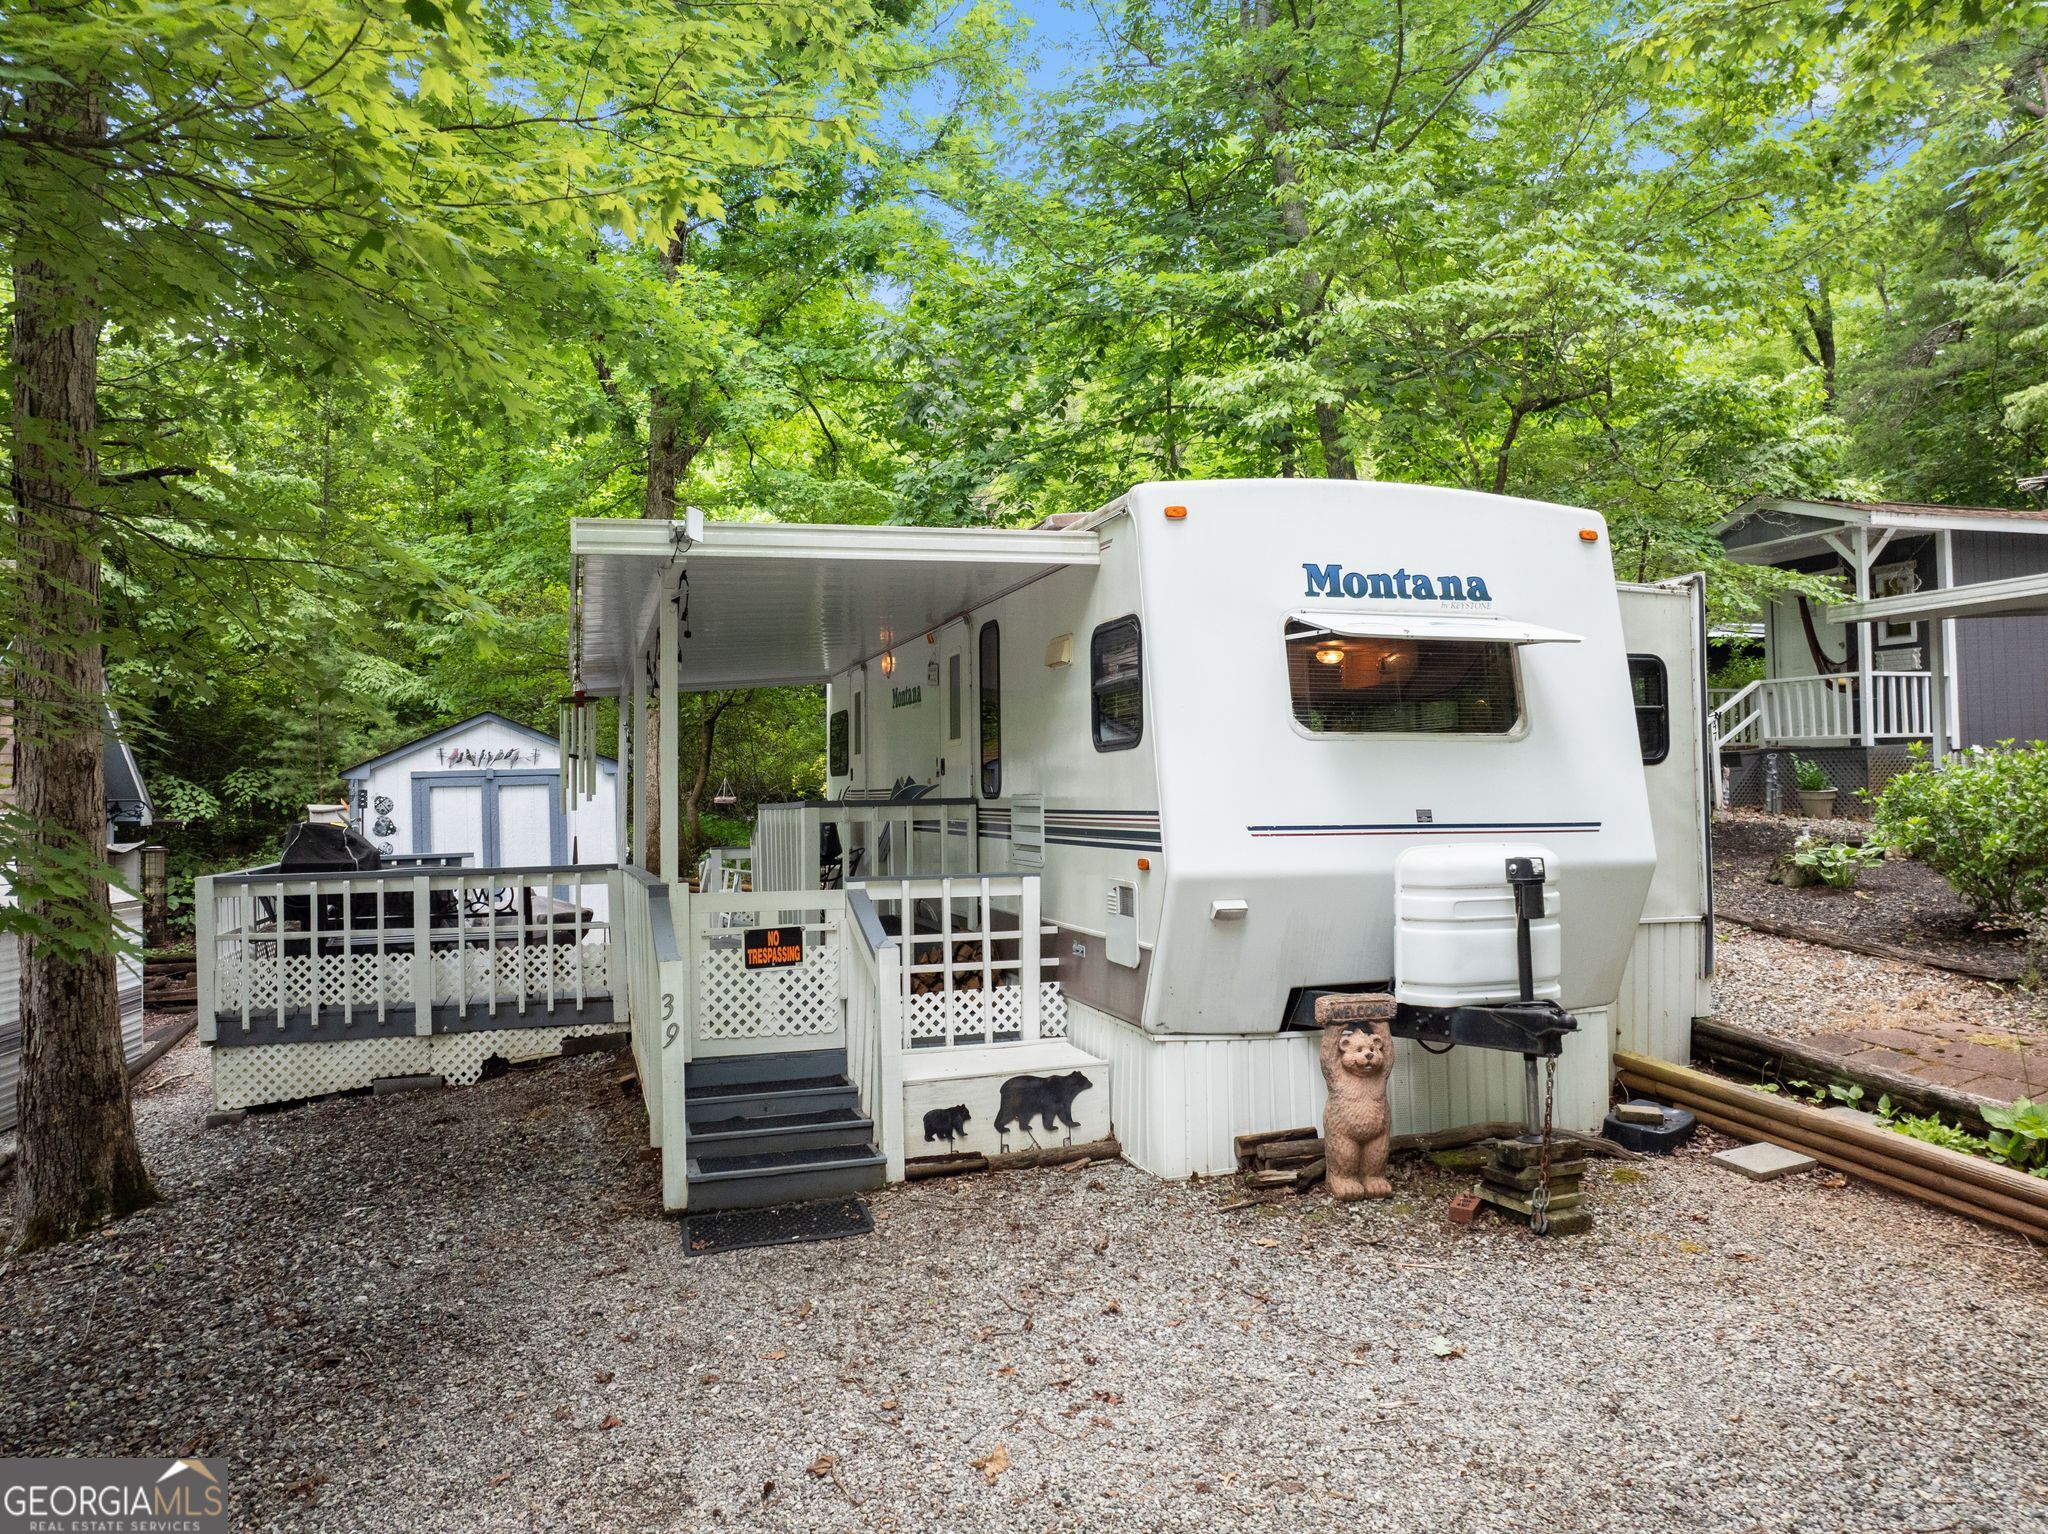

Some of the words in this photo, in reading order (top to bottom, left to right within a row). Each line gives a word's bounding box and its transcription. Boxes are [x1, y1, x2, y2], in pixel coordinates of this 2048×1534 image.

[1302, 563, 1492, 601] Montana
[1450, 601, 1492, 609] KEYSTONE
[892, 685, 921, 709] Montana
[767, 930, 780, 946] NO
[747, 945, 801, 965] TRESPASSING
[1331, 1003, 1388, 1018] WELCOME
[662, 993, 680, 1049] 39
